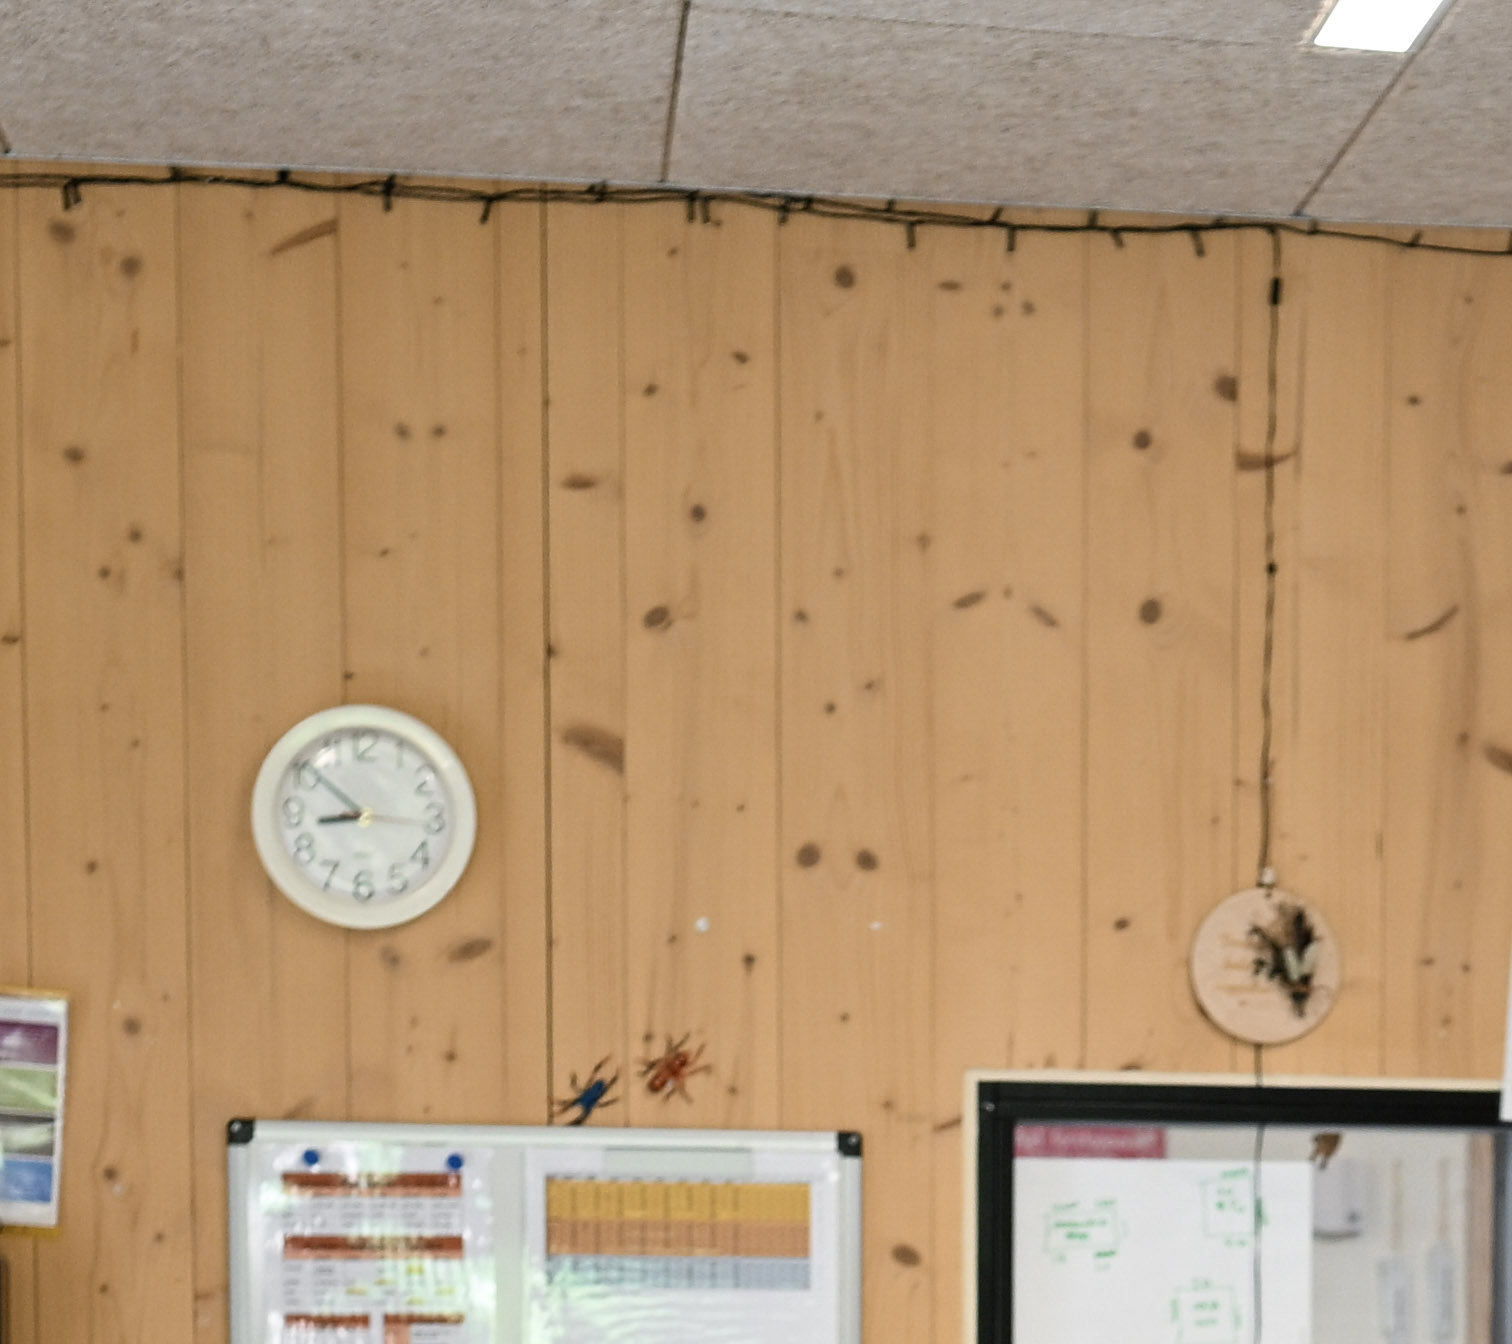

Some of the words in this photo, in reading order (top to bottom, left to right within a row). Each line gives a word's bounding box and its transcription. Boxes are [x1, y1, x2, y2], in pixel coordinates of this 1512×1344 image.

[352, 731, 379, 763] 12
[395, 740, 404, 769] 1
[414, 763, 436, 797] 2
[282, 795, 304, 829] 9
[423, 802, 445, 835] 3
[293, 832, 316, 865] 8
[410, 840, 430, 870] 4
[319, 861, 340, 892] 7
[353, 869, 375, 903] 6
[387, 862, 408, 894] 5
